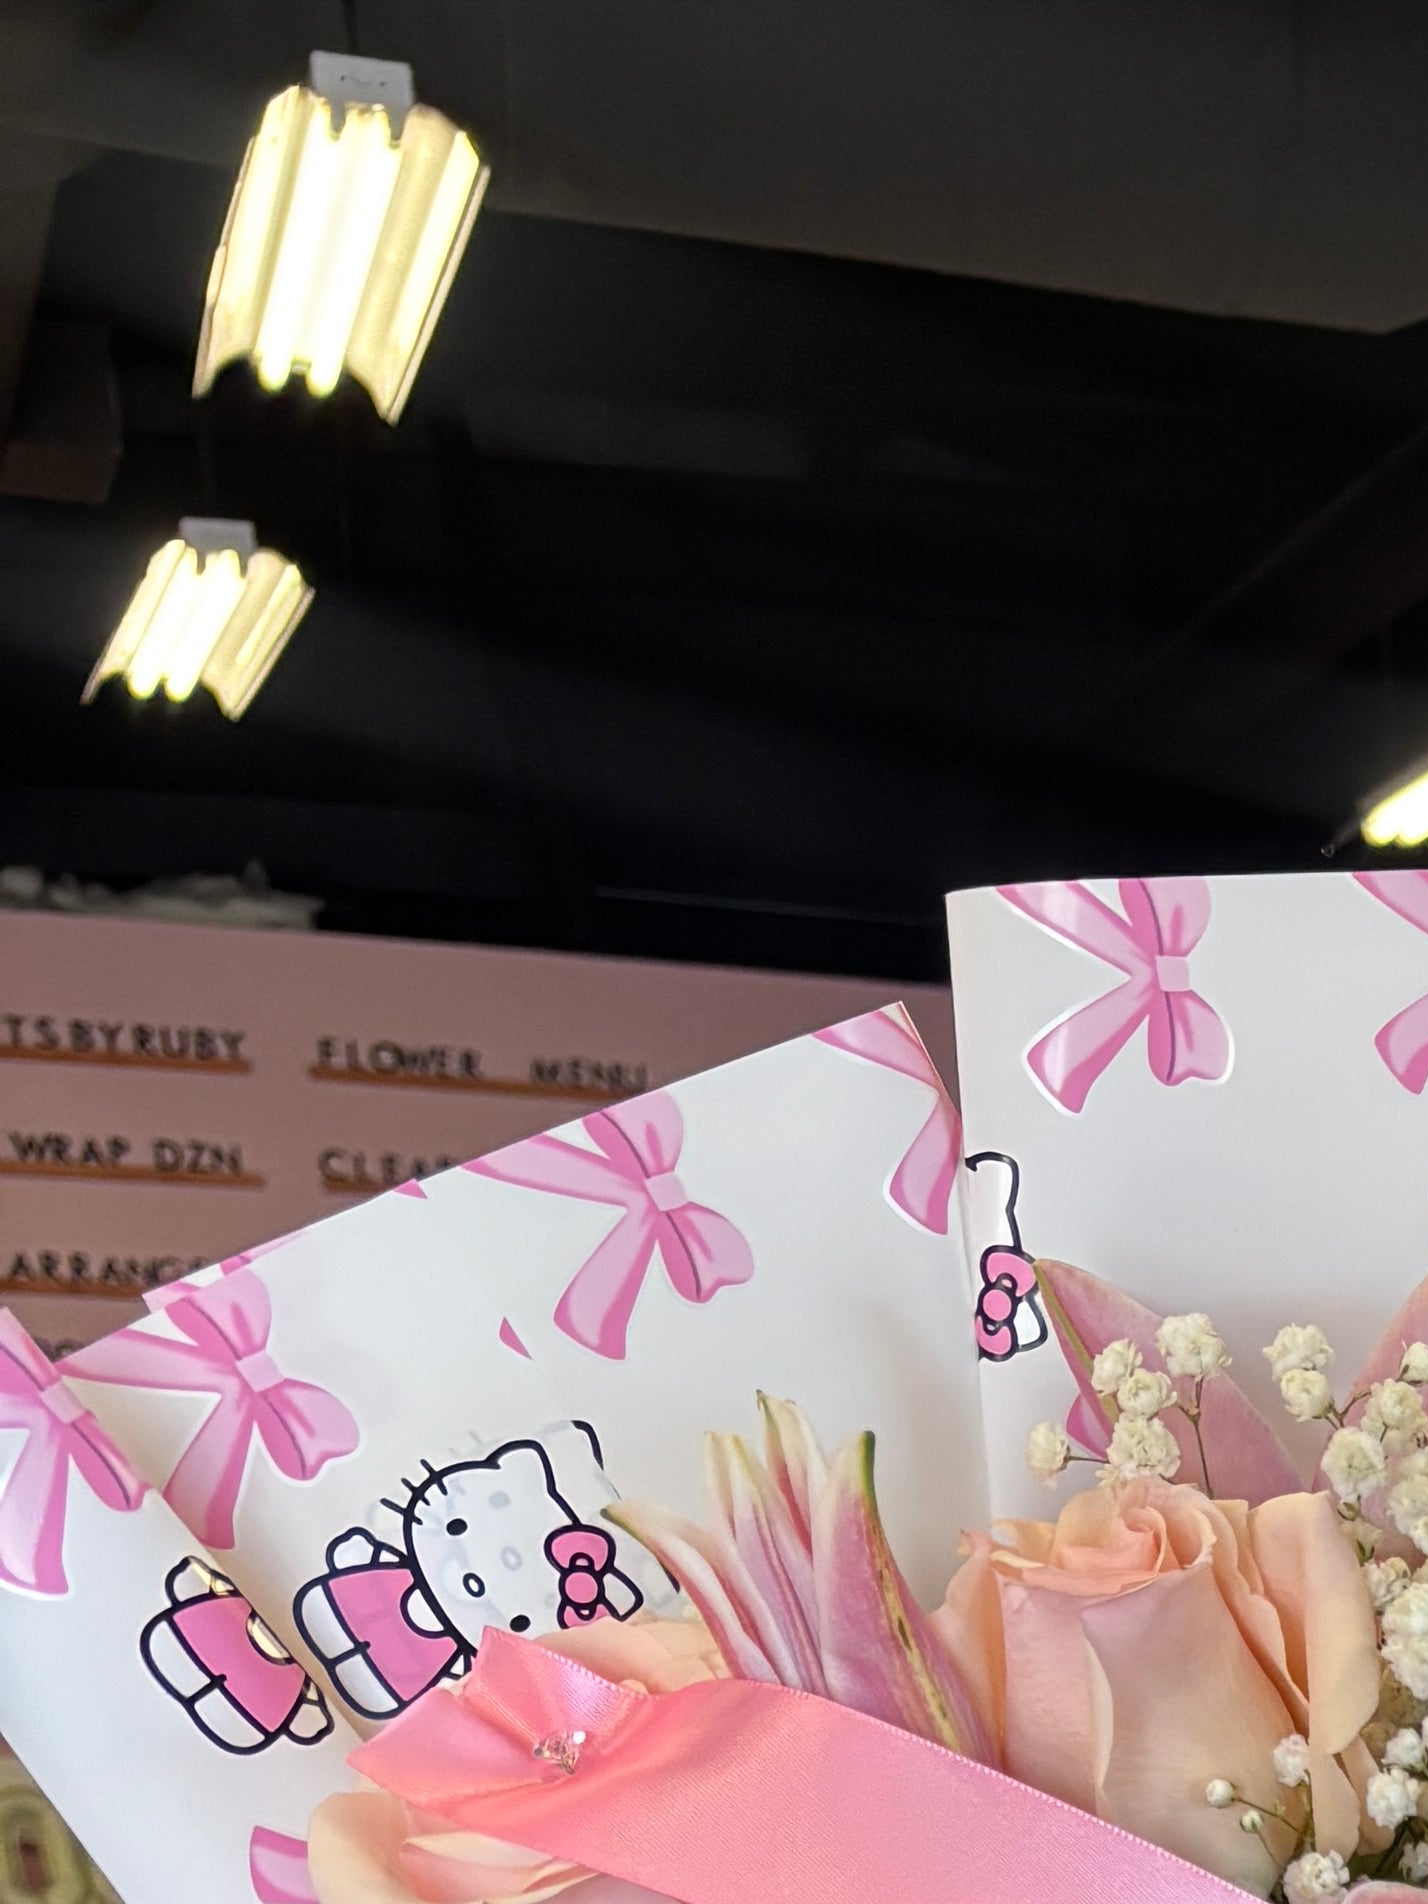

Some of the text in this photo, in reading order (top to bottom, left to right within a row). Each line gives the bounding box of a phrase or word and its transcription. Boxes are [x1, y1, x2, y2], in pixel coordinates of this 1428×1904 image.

[316, 1033, 648, 1094] FLOWER MENU
[8, 1130, 243, 1175] WRAP DZN
